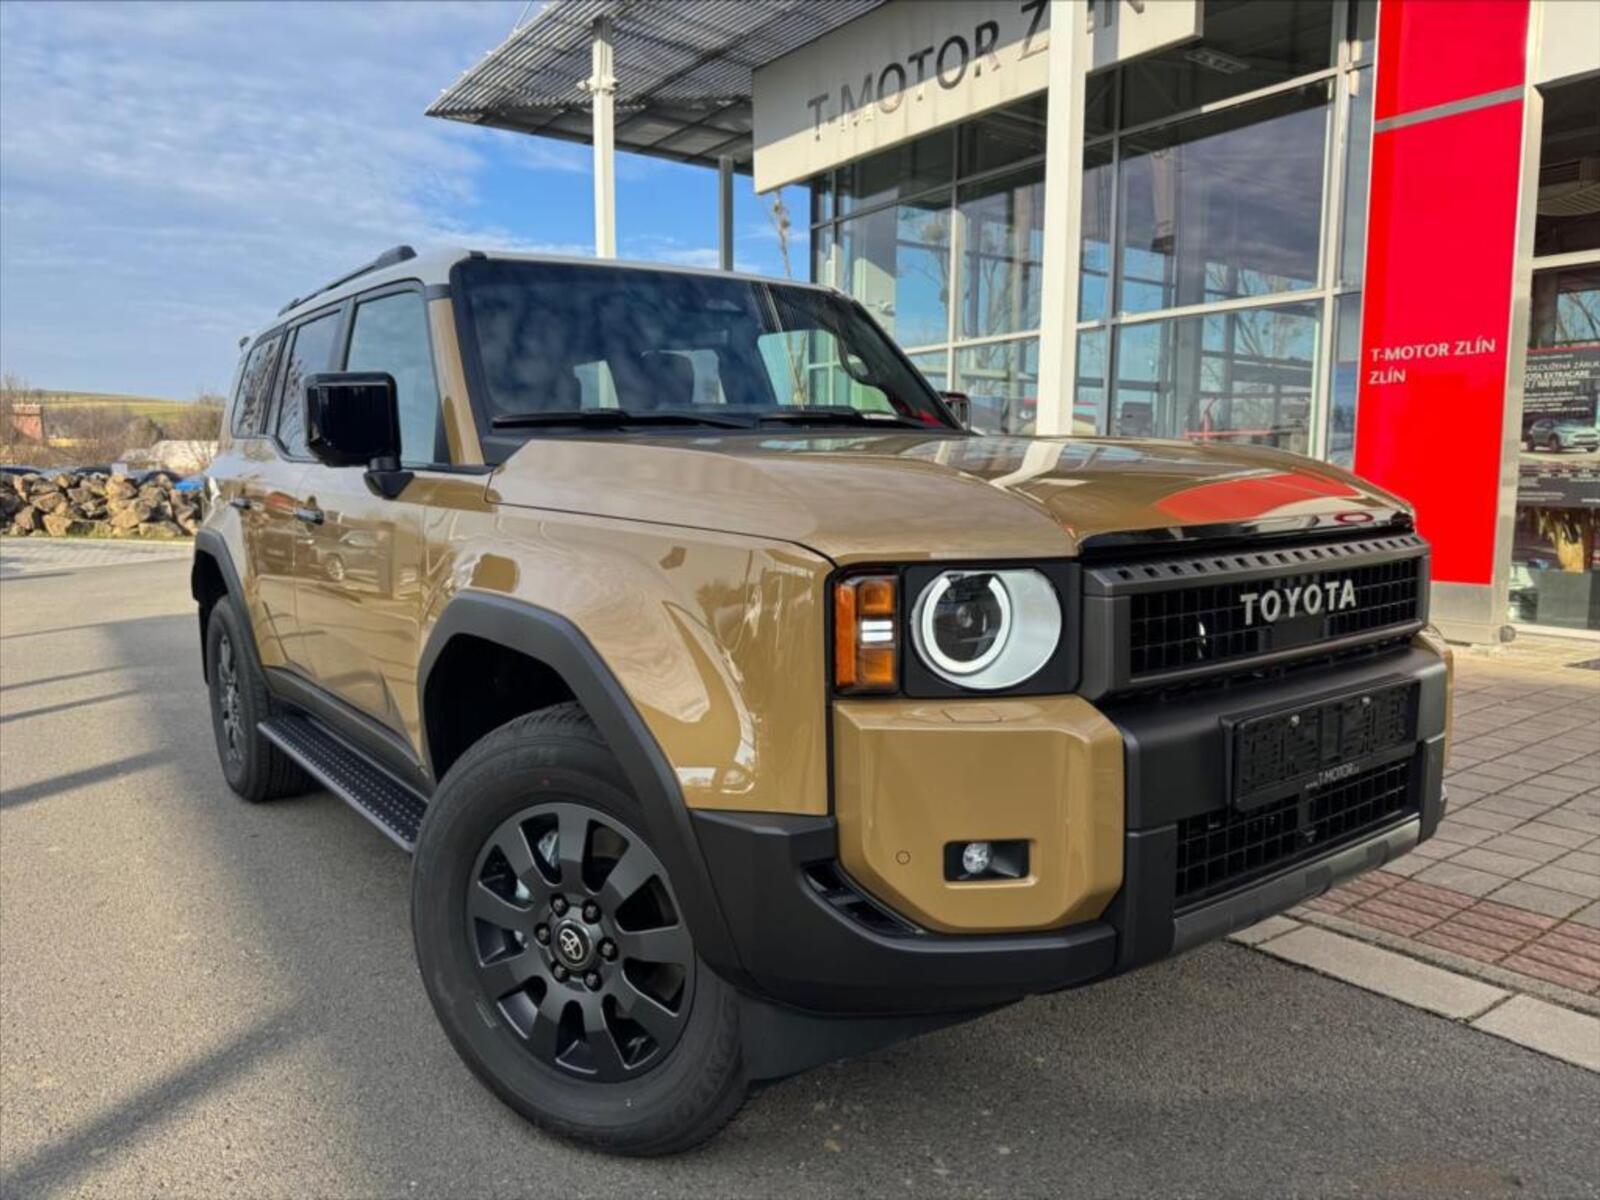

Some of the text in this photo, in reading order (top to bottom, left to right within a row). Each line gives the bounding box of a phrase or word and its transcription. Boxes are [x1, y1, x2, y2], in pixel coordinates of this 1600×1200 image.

[807, 20, 1001, 141] T-MOTOR
[1371, 335, 1496, 361] T-MOTOR ZLÍN
[1369, 366, 1406, 385] ZLÍN
[1240, 579, 1357, 626] TOYOTA
